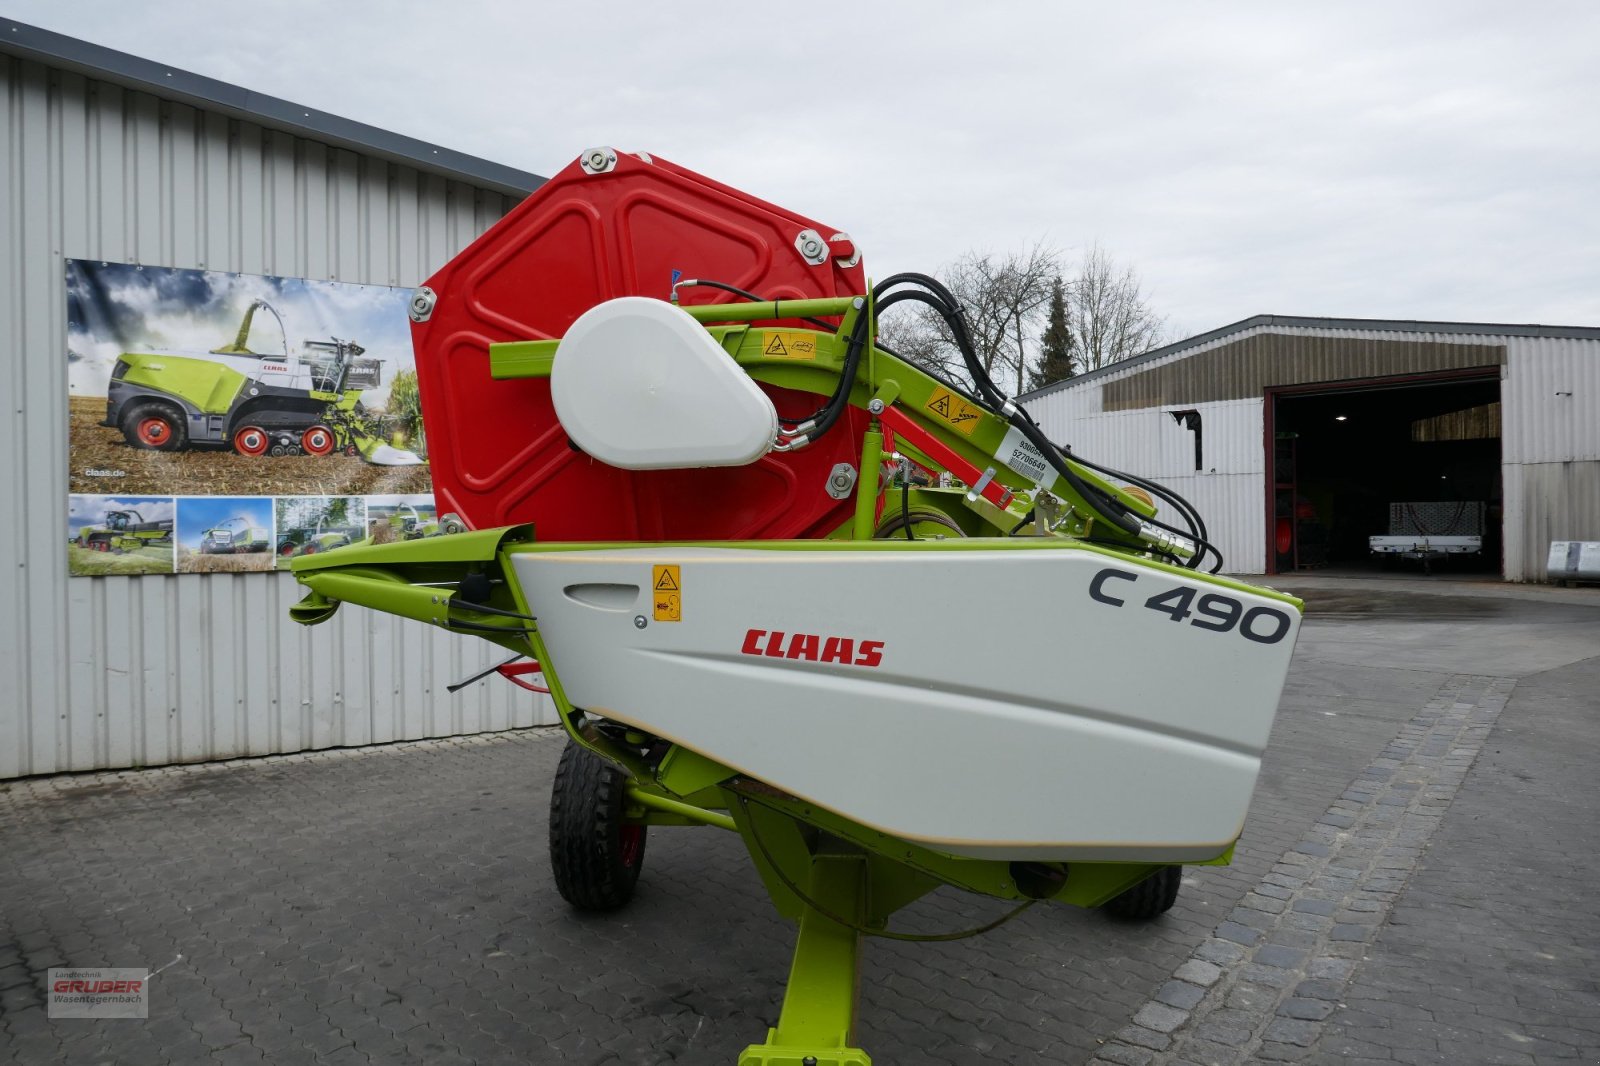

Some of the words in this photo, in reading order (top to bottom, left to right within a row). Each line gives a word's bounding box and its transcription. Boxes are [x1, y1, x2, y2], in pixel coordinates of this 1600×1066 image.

[85, 468, 125, 477] claas.de
[1012, 449, 1046, 471] 52706649
[1088, 568, 1139, 607] C
[1144, 586, 1291, 644] 490
[741, 628, 885, 667] CLAAS
